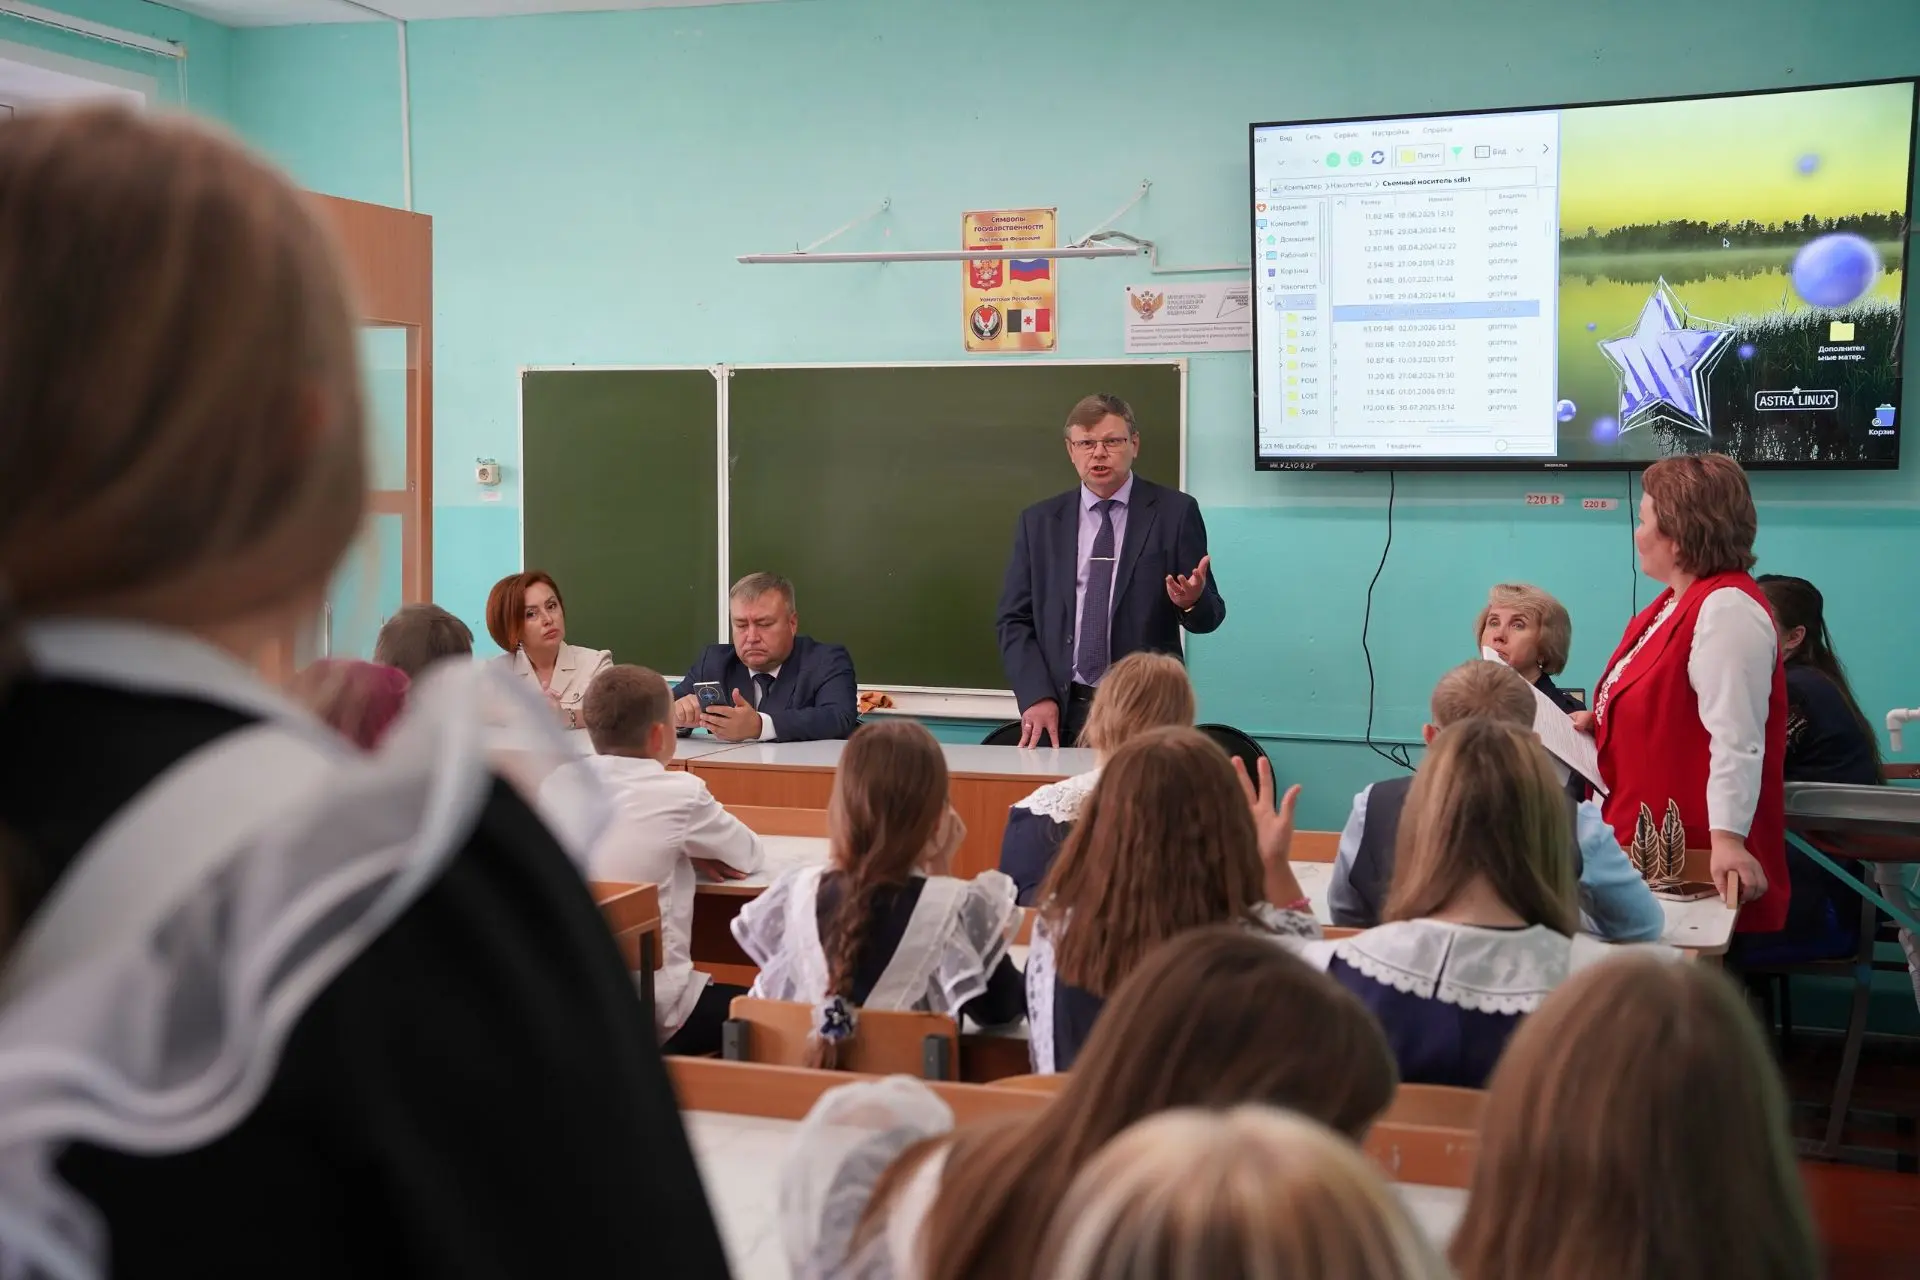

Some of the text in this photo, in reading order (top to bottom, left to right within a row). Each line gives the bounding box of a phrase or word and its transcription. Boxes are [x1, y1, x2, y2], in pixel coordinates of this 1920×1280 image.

[1372, 128, 1409, 137] Настройка
[974, 224, 1044, 232] государственности
[1818, 345, 1865, 353] Дополнител
[1759, 395, 1795, 406] ASTRA
[1527, 495, 1547, 505] 220
